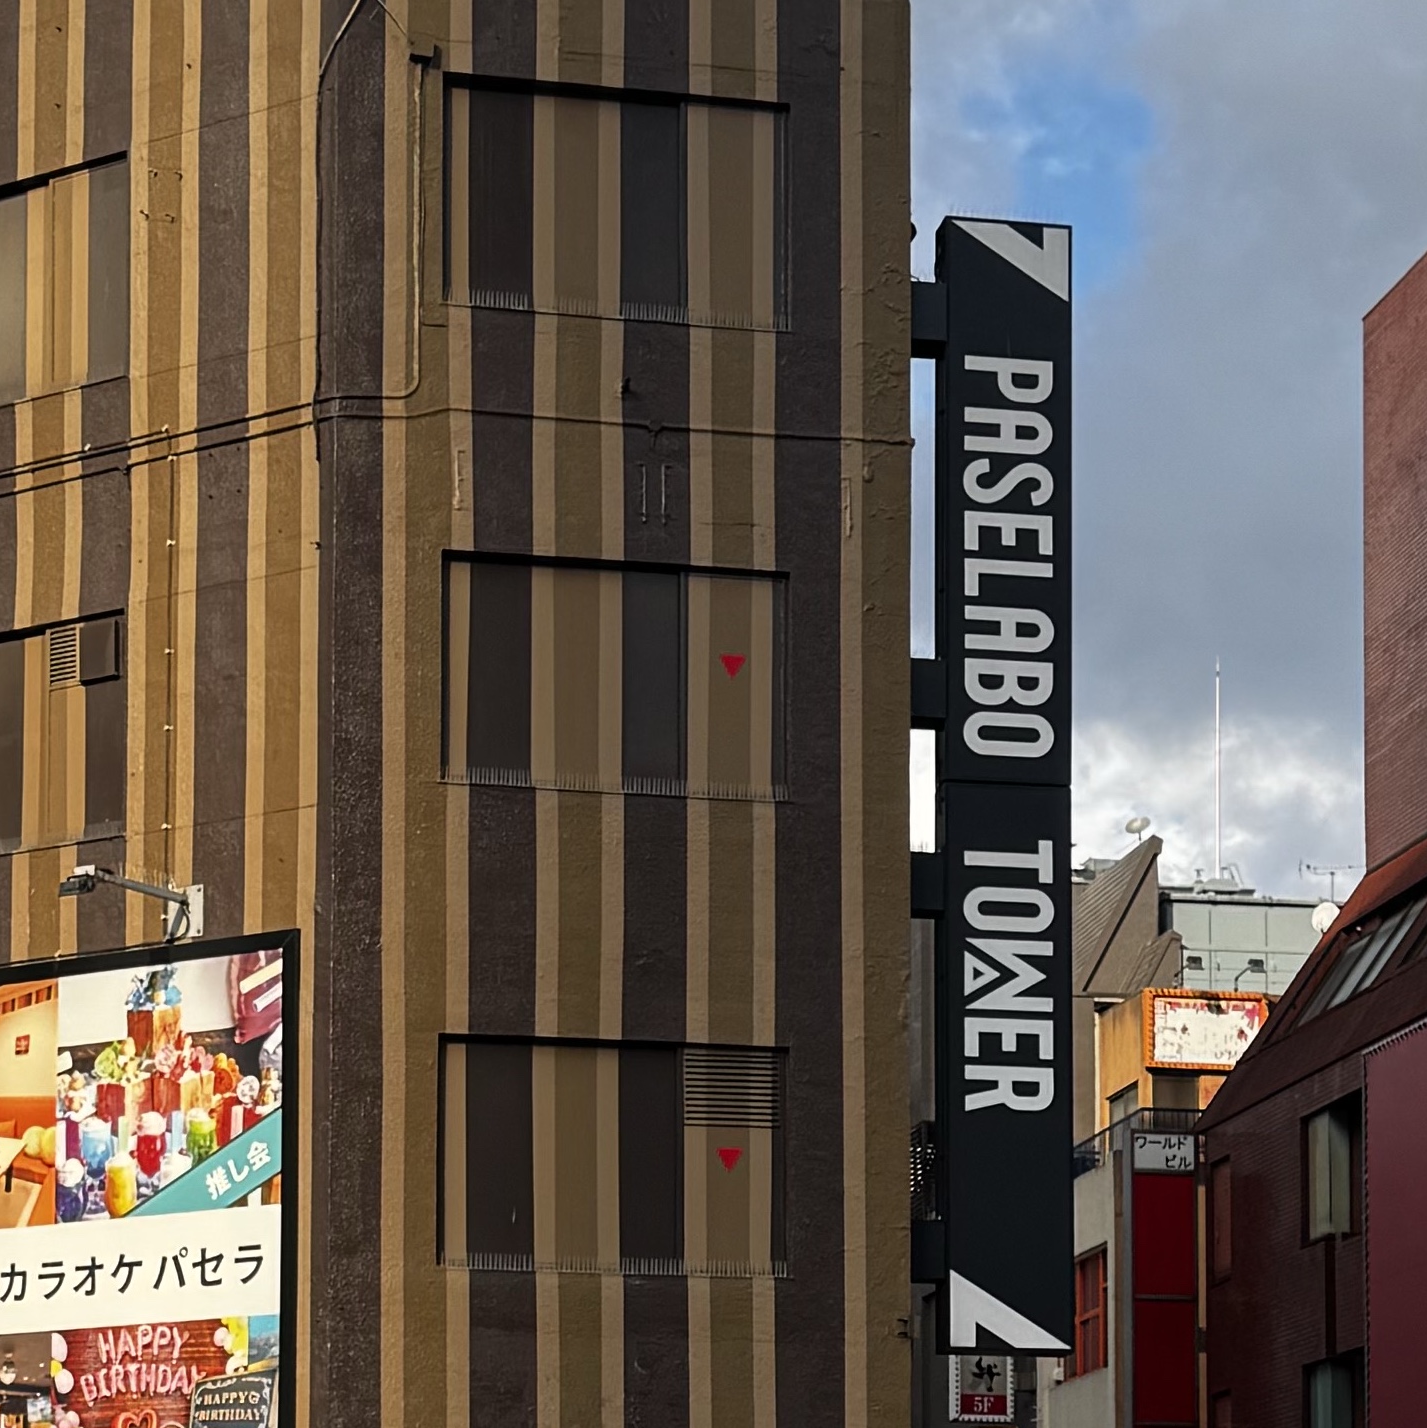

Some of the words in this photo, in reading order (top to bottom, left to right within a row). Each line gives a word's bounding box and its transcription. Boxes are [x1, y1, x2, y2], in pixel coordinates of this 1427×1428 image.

[963, 353, 1055, 760] PASELABO
[963, 837, 1055, 1115] TOWER
[1134, 1136, 1189, 1152] ワールド
[1164, 1156, 1193, 1172] ビル
[205, 1140, 272, 1201] 推し会
[97, 1323, 192, 1364] HAPPY
[79, 1360, 208, 1408] BIRTHDAY
[973, 1396, 995, 1413] 5F
